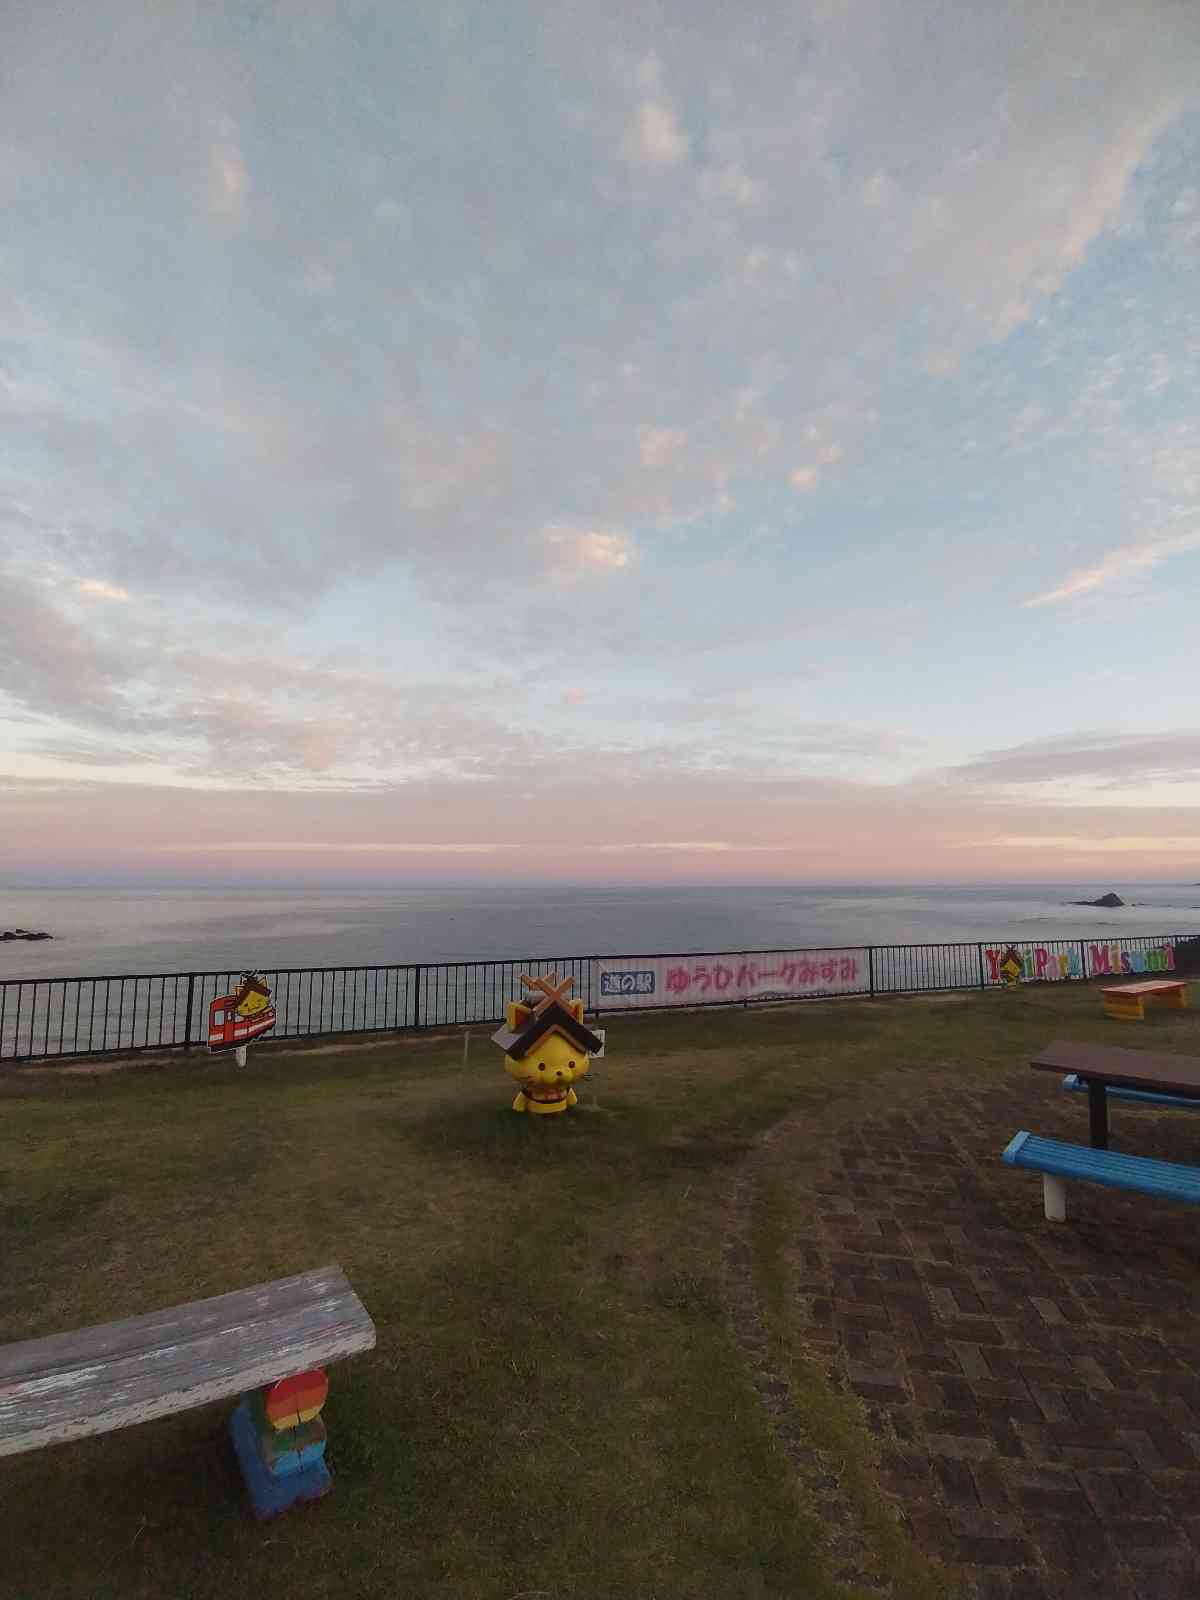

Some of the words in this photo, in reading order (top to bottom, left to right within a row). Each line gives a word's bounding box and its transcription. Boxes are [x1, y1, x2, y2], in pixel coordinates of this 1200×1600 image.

[603, 973, 654, 993] 道の駅
[665, 959, 857, 994] ゆうひパークみすみ
